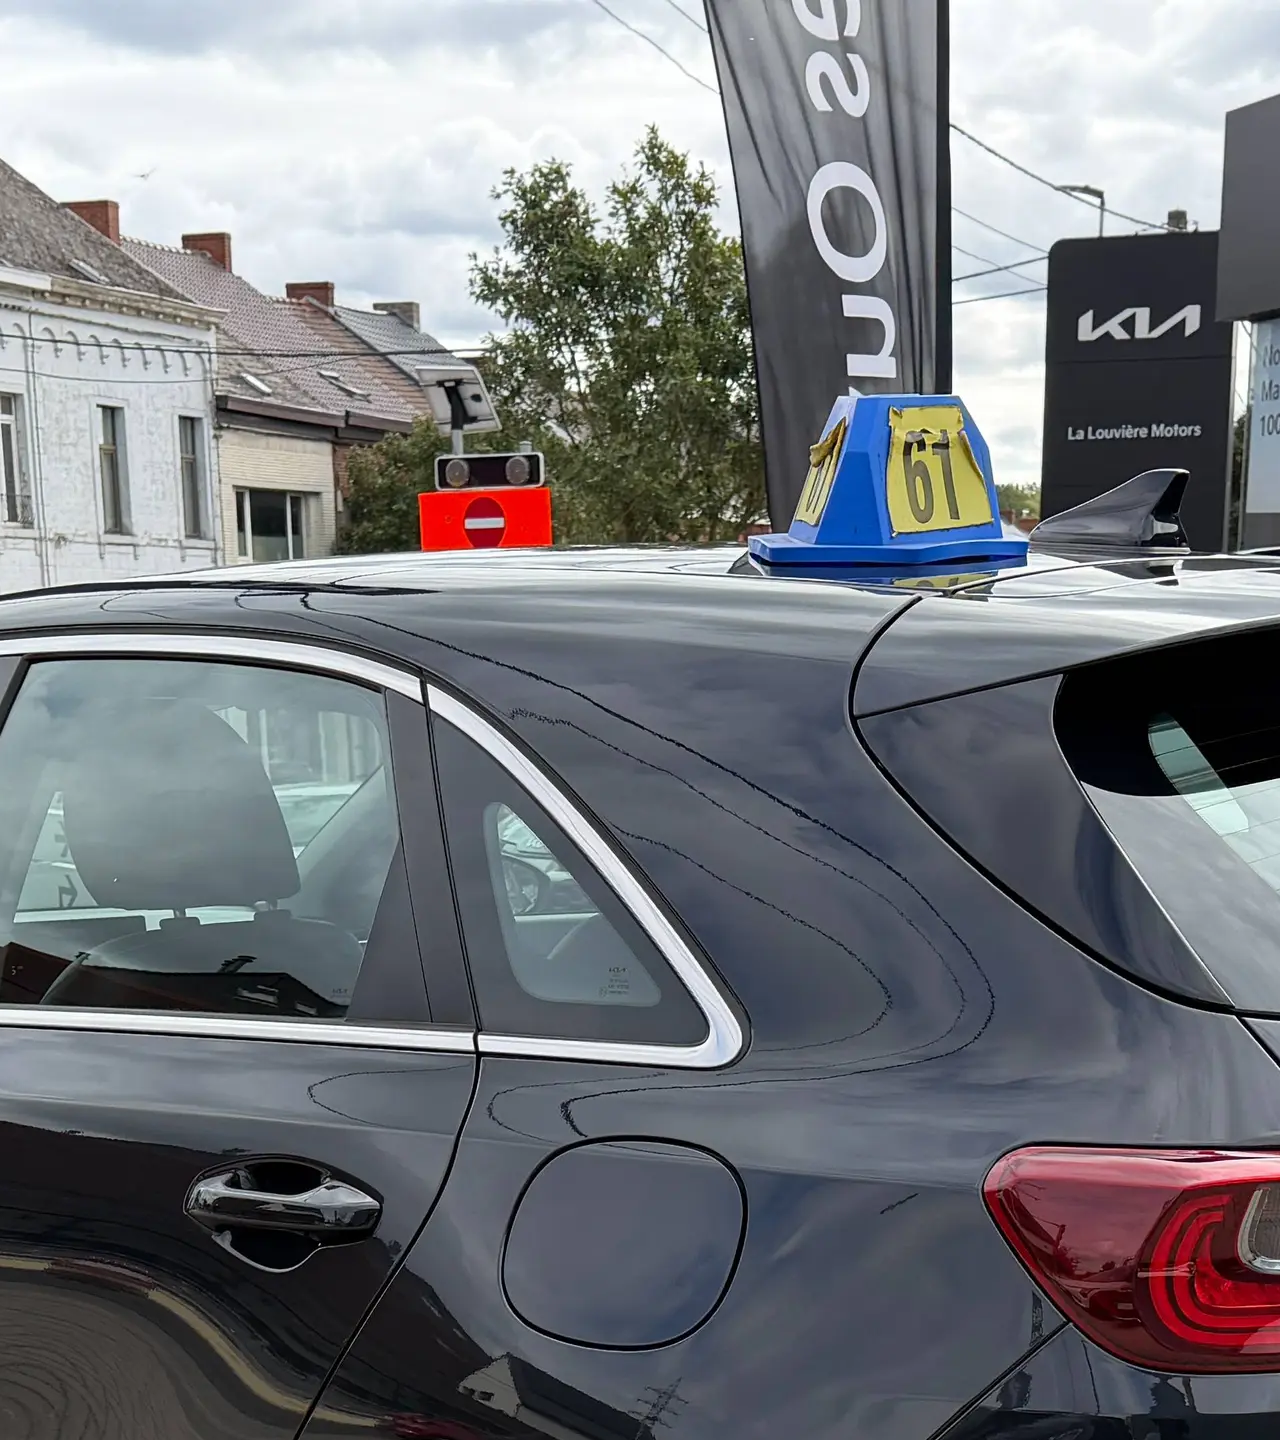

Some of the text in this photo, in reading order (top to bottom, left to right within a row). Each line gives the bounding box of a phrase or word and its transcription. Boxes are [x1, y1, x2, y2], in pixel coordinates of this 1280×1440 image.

[1077, 304, 1201, 341] KIA
[1261, 379, 1280, 402] Ma
[1067, 423, 1202, 441] La Louvière Motors
[902, 428, 961, 525] 61
